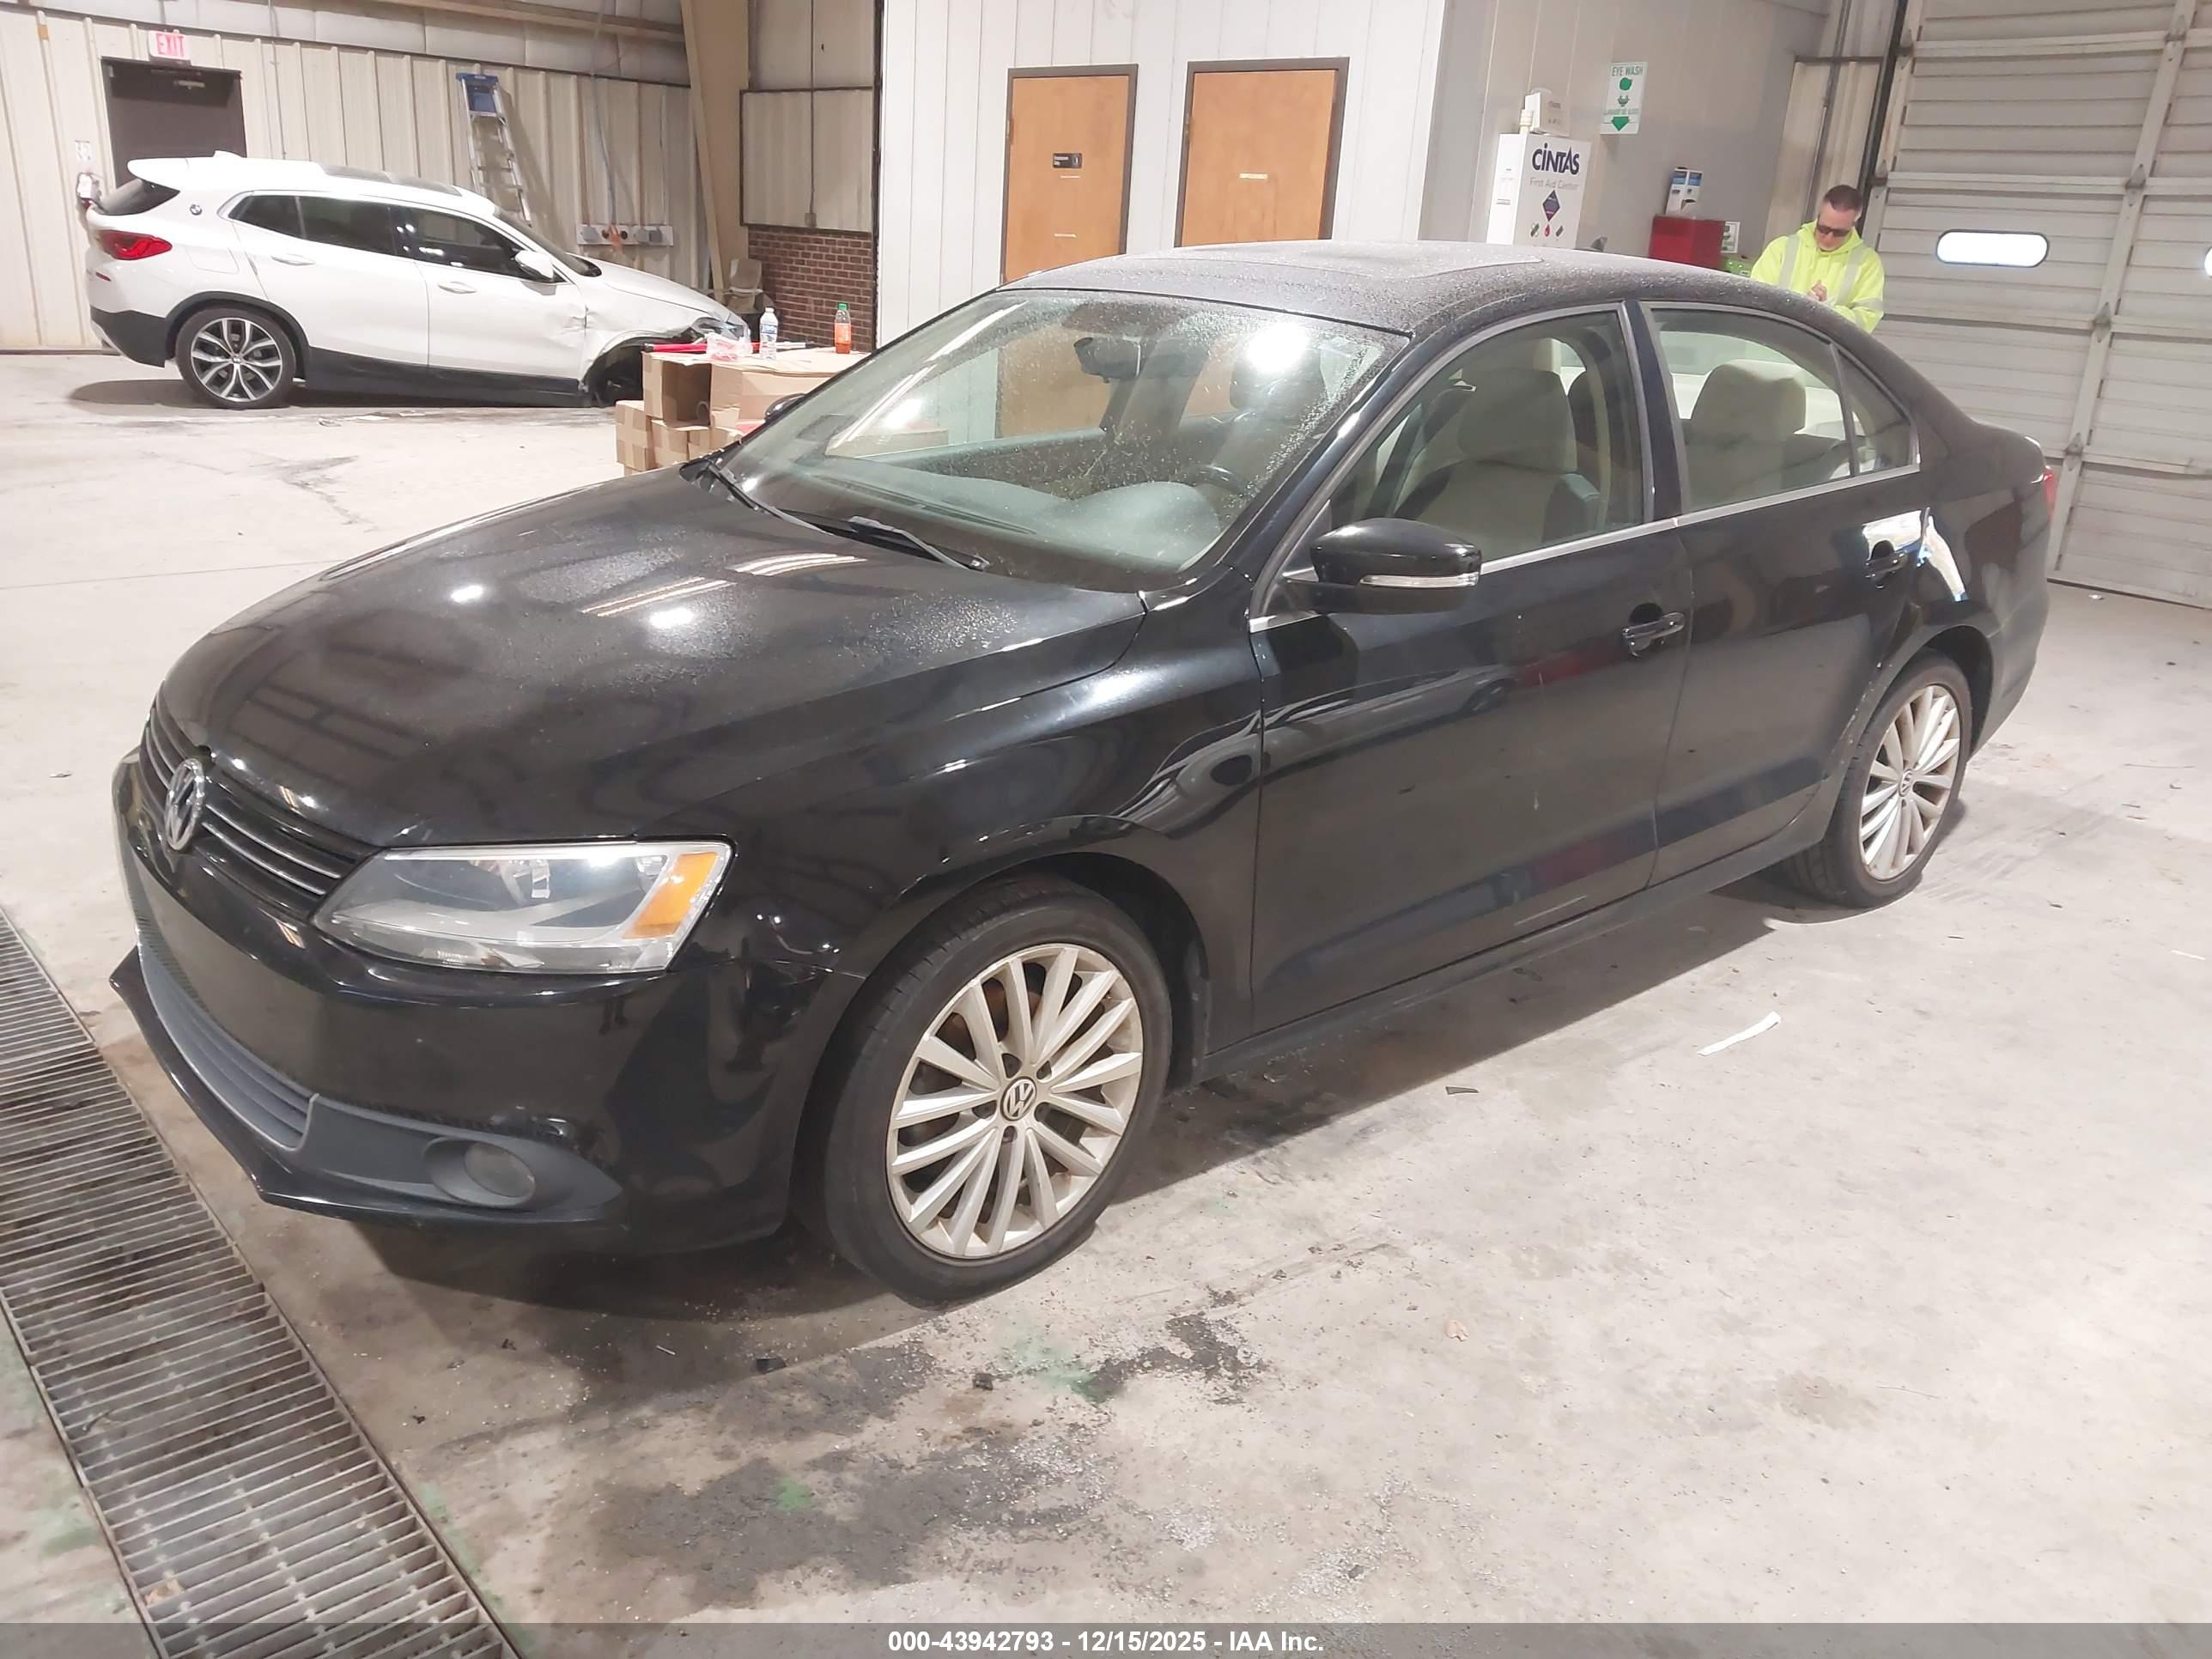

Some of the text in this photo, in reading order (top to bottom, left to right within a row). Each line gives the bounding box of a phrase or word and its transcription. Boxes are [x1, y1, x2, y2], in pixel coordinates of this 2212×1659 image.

[155, 33, 185, 57] EXIT
[1612, 65, 1643, 76] EYE WASH
